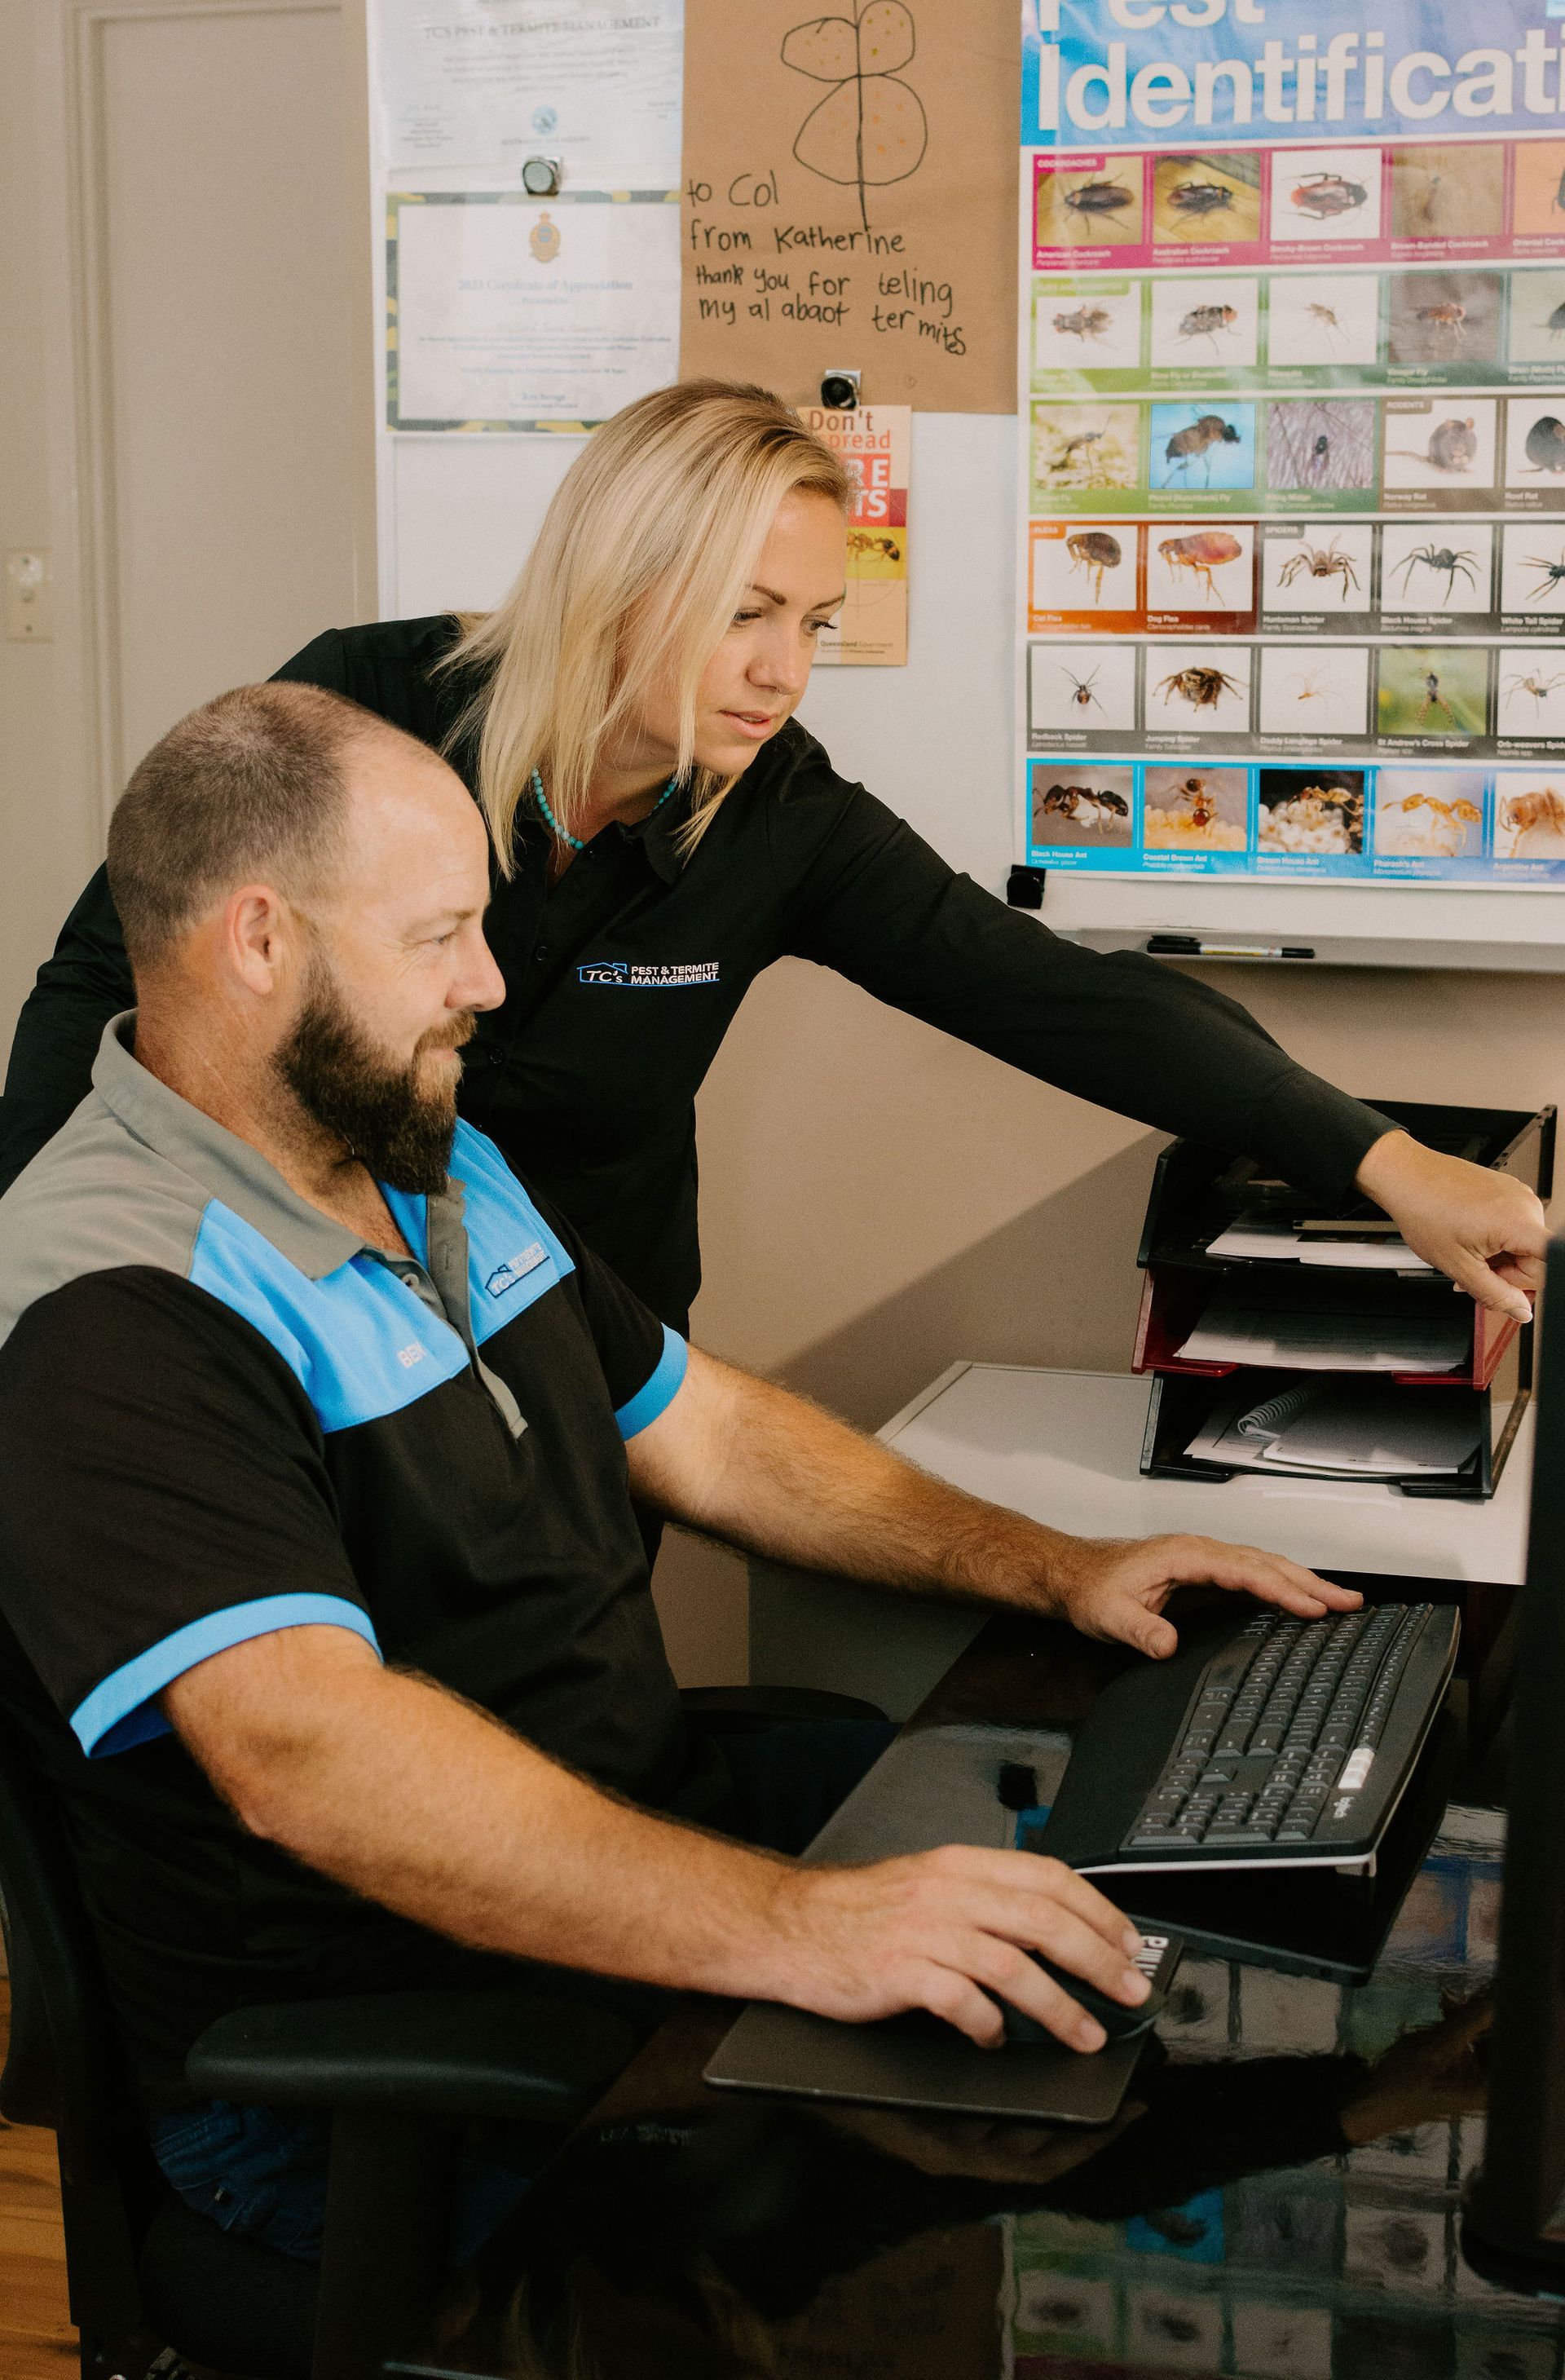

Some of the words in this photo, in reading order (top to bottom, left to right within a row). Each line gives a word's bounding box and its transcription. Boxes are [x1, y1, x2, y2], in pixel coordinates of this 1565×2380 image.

[1038, 22, 1565, 130] Identificat
[687, 179, 712, 207] to
[729, 170, 778, 207] Col
[690, 219, 752, 251] from
[774, 225, 906, 254] Katherine
[696, 263, 744, 285] thank
[754, 268, 789, 294] you
[809, 271, 851, 296] for
[879, 267, 953, 318] teling
[699, 298, 735, 325] my
[748, 298, 769, 321] al
[809, 410, 874, 431] Don't
[1031, 850, 1051, 858] Black
[1051, 850, 1073, 859] House
[586, 969, 623, 983] TC's
[631, 966, 659, 975] PEST
[660, 965, 670, 975] &
[670, 961, 720, 975] TERMITE
[630, 970, 719, 985] MANAGEMENT
